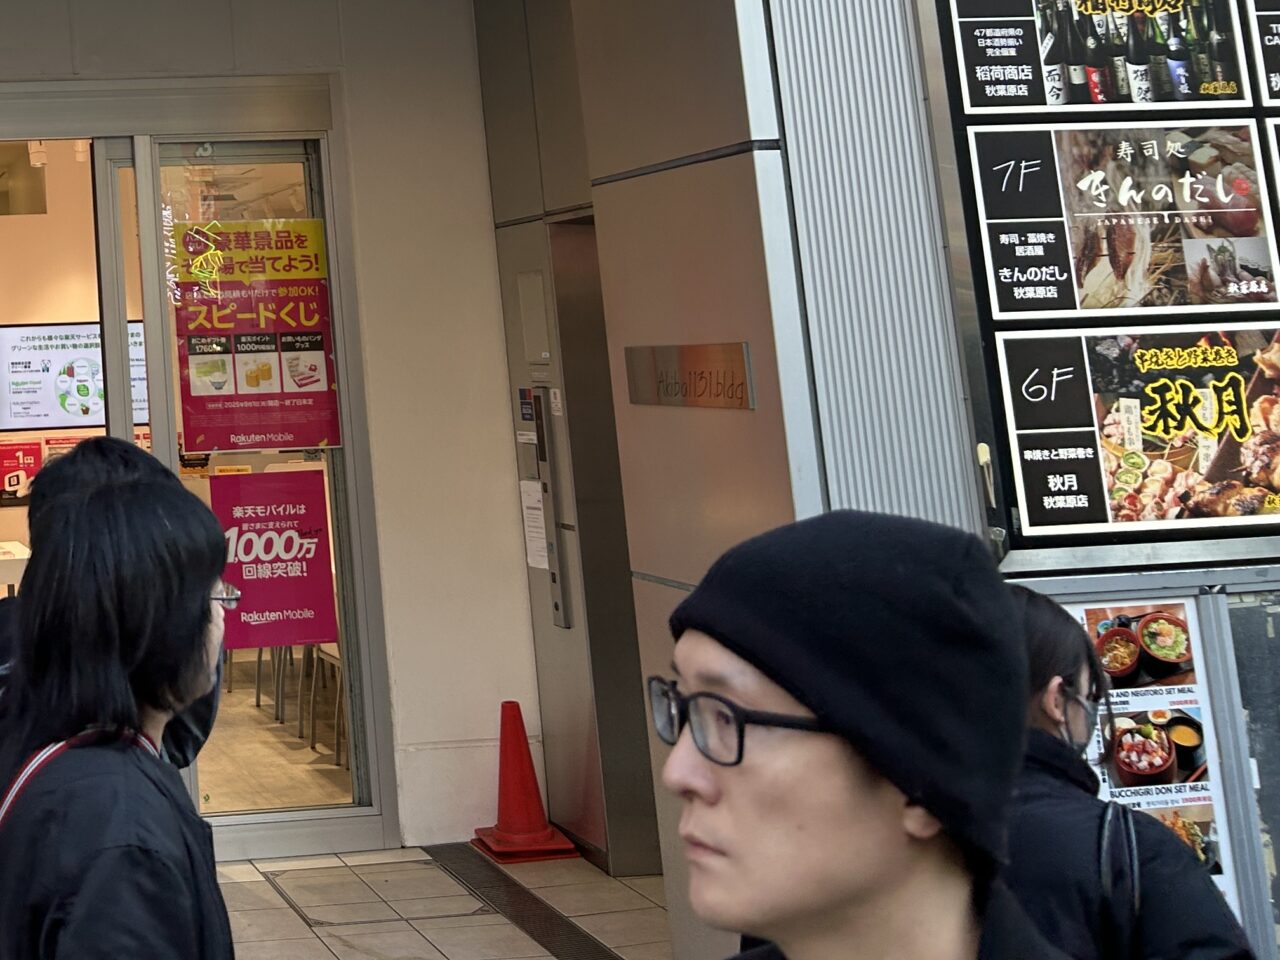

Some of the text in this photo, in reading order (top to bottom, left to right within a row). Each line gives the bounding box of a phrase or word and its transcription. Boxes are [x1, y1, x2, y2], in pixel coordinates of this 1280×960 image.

[974, 27, 1023, 38] 47都道府県の
[976, 65, 1032, 81] 稲荷商店
[985, 84, 1028, 97] 秋葉原店
[1117, 140, 1187, 161] 寿司処
[993, 159, 1041, 192] 7F
[1077, 170, 1234, 207] きんのだし
[1097, 215, 1213, 226] JAPANESE DASHI
[1015, 245, 1044, 257] 居酒屋
[999, 266, 1067, 282] きんのだし
[1013, 286, 1058, 299] 秋葉原店
[187, 302, 319, 330] スピードくじ
[1021, 367, 1074, 402] 6F
[1141, 372, 1252, 443] 秋月
[230, 432, 294, 444] Rakuten Mobile
[1048, 474, 1078, 492] 秋月
[1043, 495, 1088, 508] 秋葉原店
[232, 504, 306, 519] 楽天モバイルは
[242, 562, 308, 580] 回線突破!
[241, 608, 314, 624] Rakuten Mobile
[1116, 689, 1130, 698] AND
[1131, 688, 1162, 698] NEGITORO
[1165, 687, 1176, 695] SET
[1177, 686, 1195, 694] MEAL
[1110, 782, 1210, 800] BUCCHIGIRI DON SET MEAL
